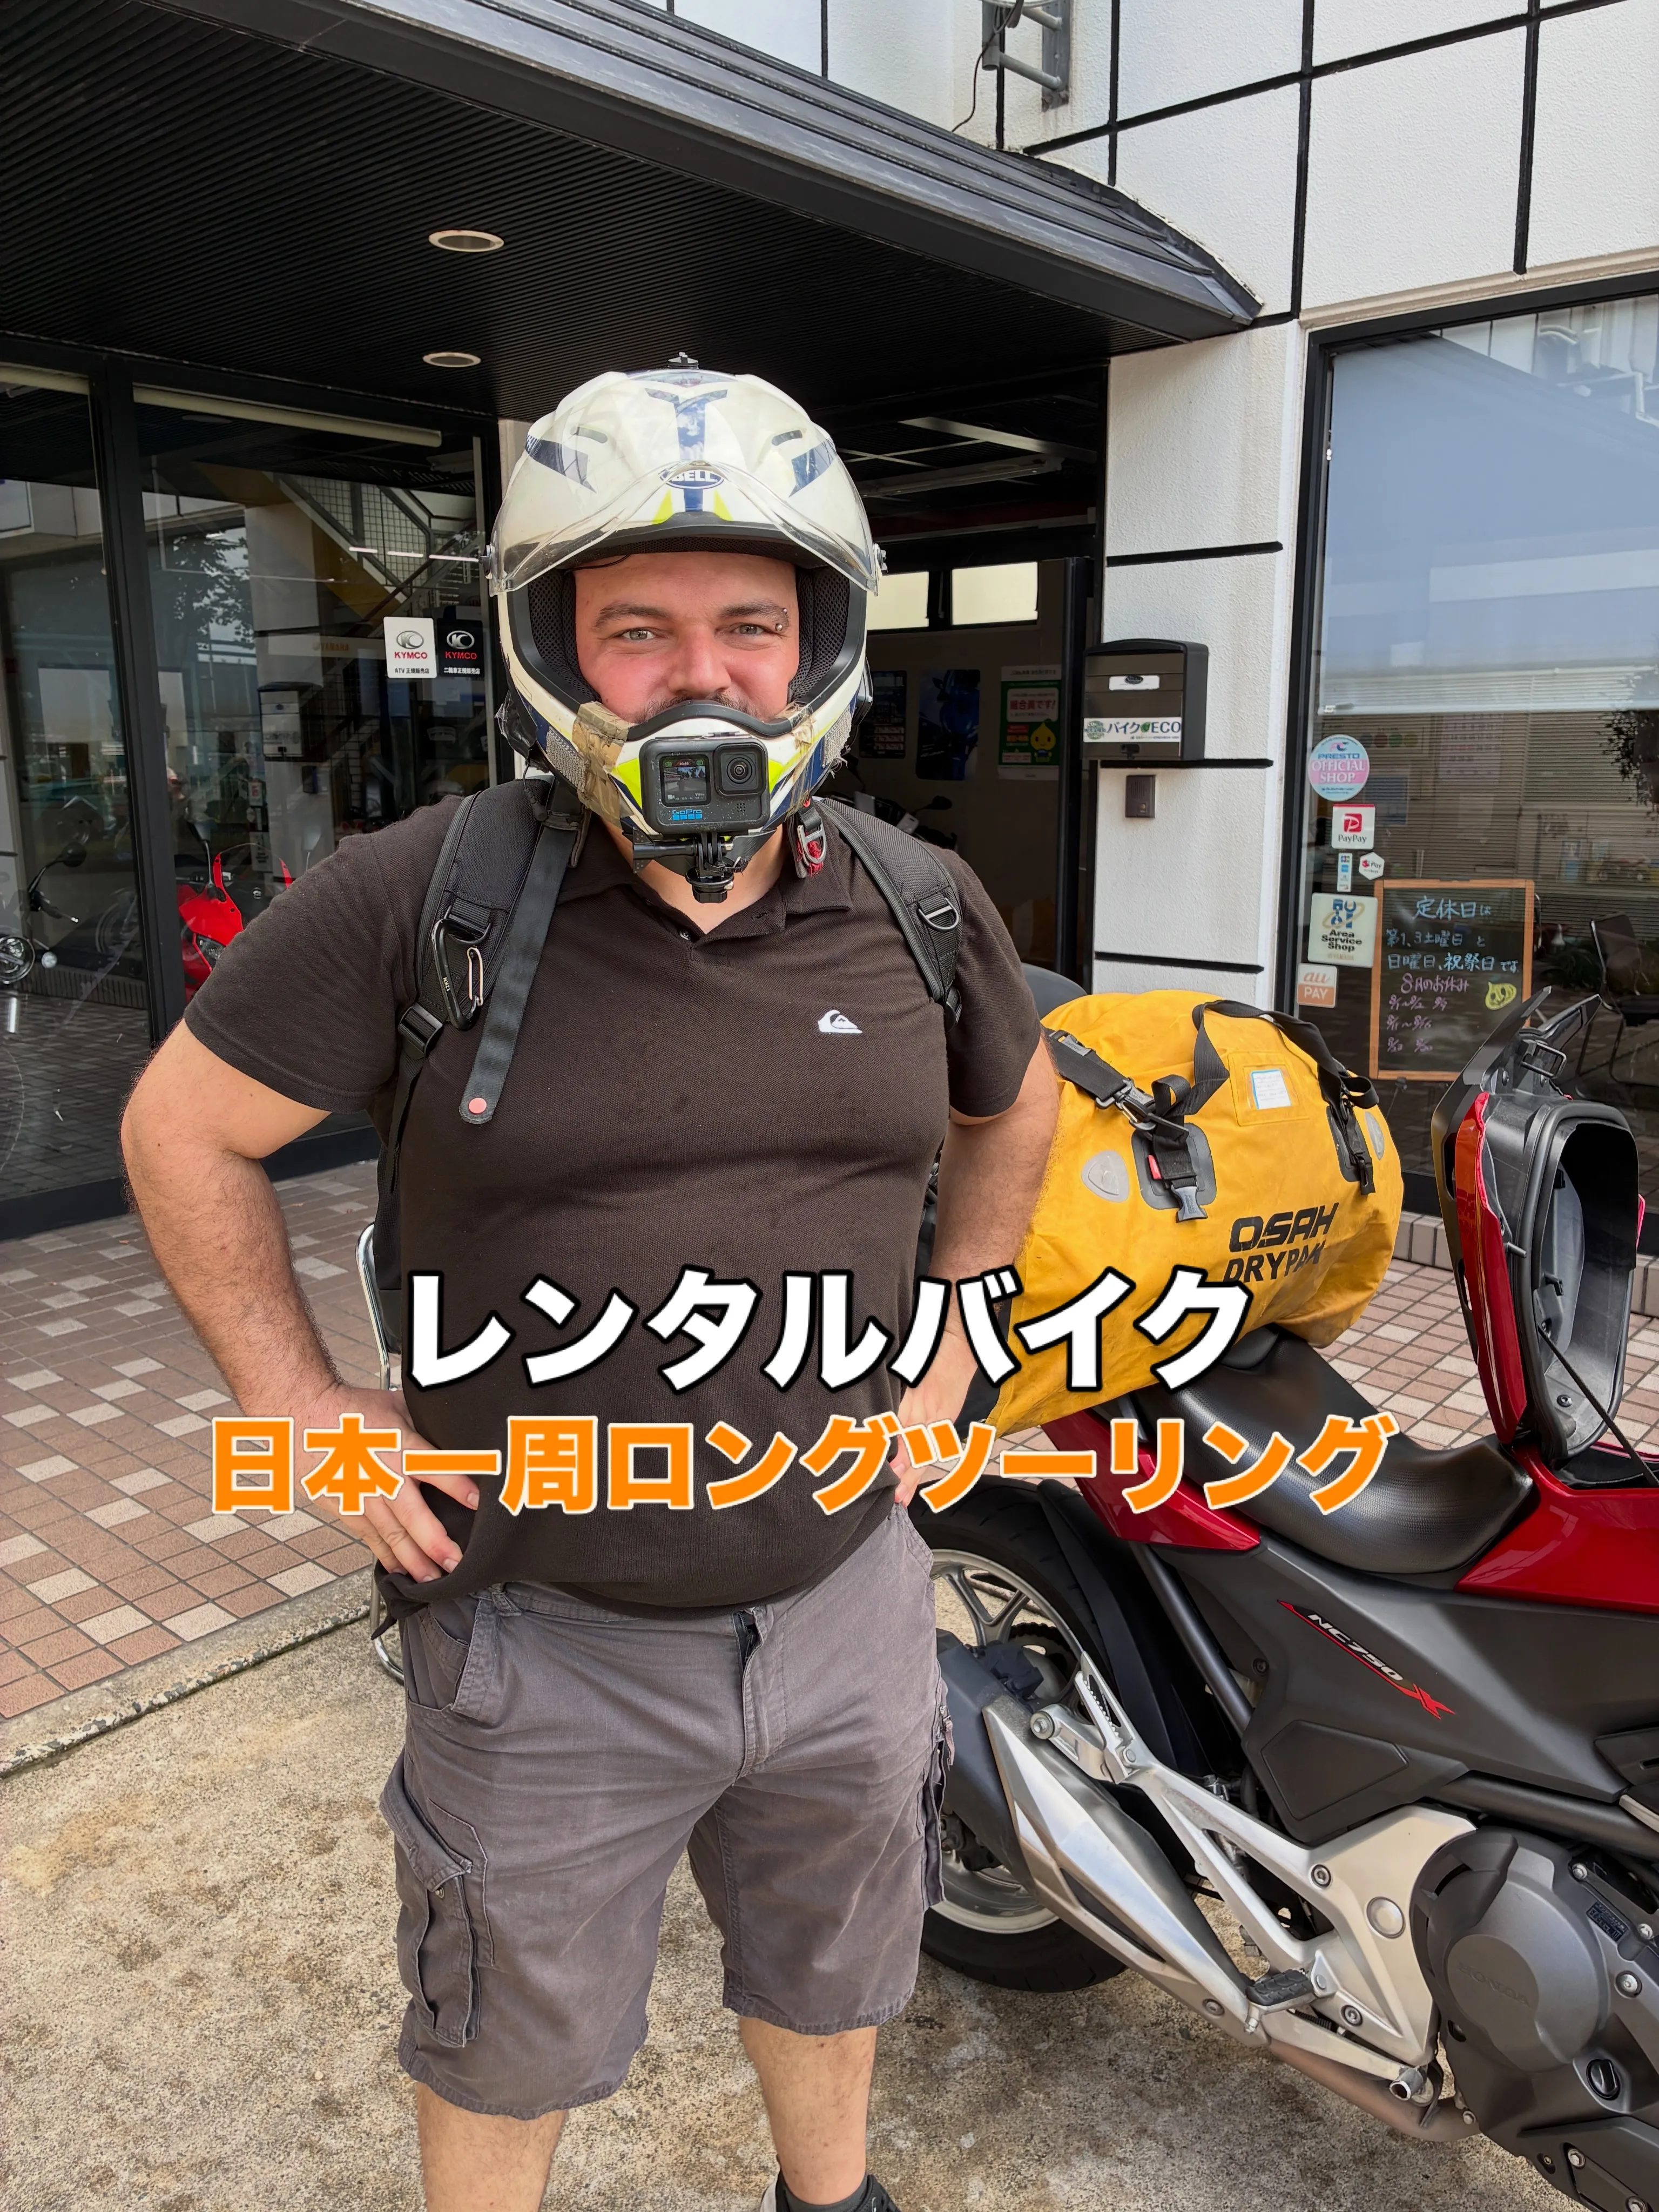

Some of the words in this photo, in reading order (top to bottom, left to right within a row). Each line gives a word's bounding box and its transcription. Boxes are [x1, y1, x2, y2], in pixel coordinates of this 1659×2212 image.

[670, 469, 716, 482] BELL
[394, 651, 428, 659] KYMCO
[444, 651, 477, 660] KYMCO
[1107, 721, 1140, 734] バイク
[1151, 721, 1182, 733] ECO
[1311, 760, 1366, 772] OFFICIAL
[1319, 772, 1356, 783] SHOP
[1338, 834, 1367, 844] PayPay
[1371, 861, 1382, 869] Pay
[1329, 928, 1355, 938] Area
[1321, 935, 1363, 946] Service
[1327, 942, 1355, 953] Shop
[1303, 972, 1330, 983] au
[1304, 987, 1328, 1000] PAY
[1229, 1202, 1339, 1253] OSAH
[1223, 1239, 1327, 1283] DRYPAK
[1458, 1960, 1531, 2008] HONDA
